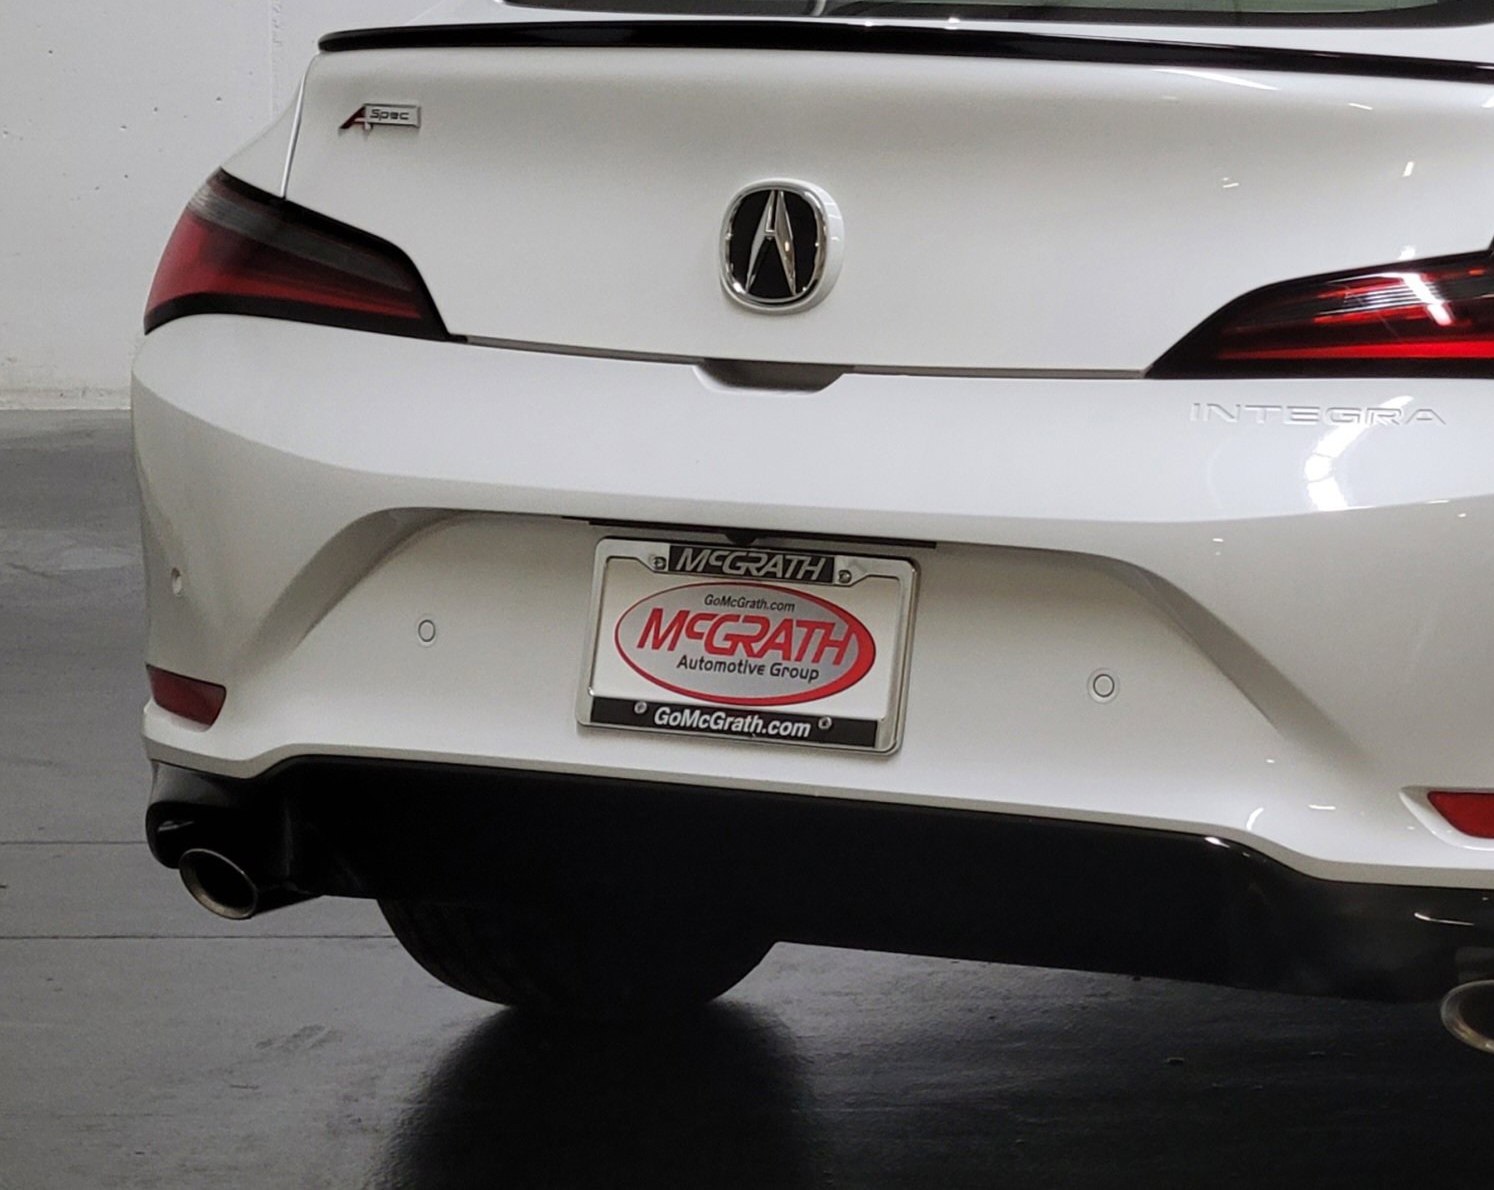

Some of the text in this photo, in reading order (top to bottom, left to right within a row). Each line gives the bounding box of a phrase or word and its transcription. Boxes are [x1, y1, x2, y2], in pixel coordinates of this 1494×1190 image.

[1190, 402, 1446, 425] INTEGRA
[703, 594, 796, 613] GoMcGrath.com
[676, 654, 820, 684] Automotive Group
[654, 706, 812, 738] GoMcGrath.com
